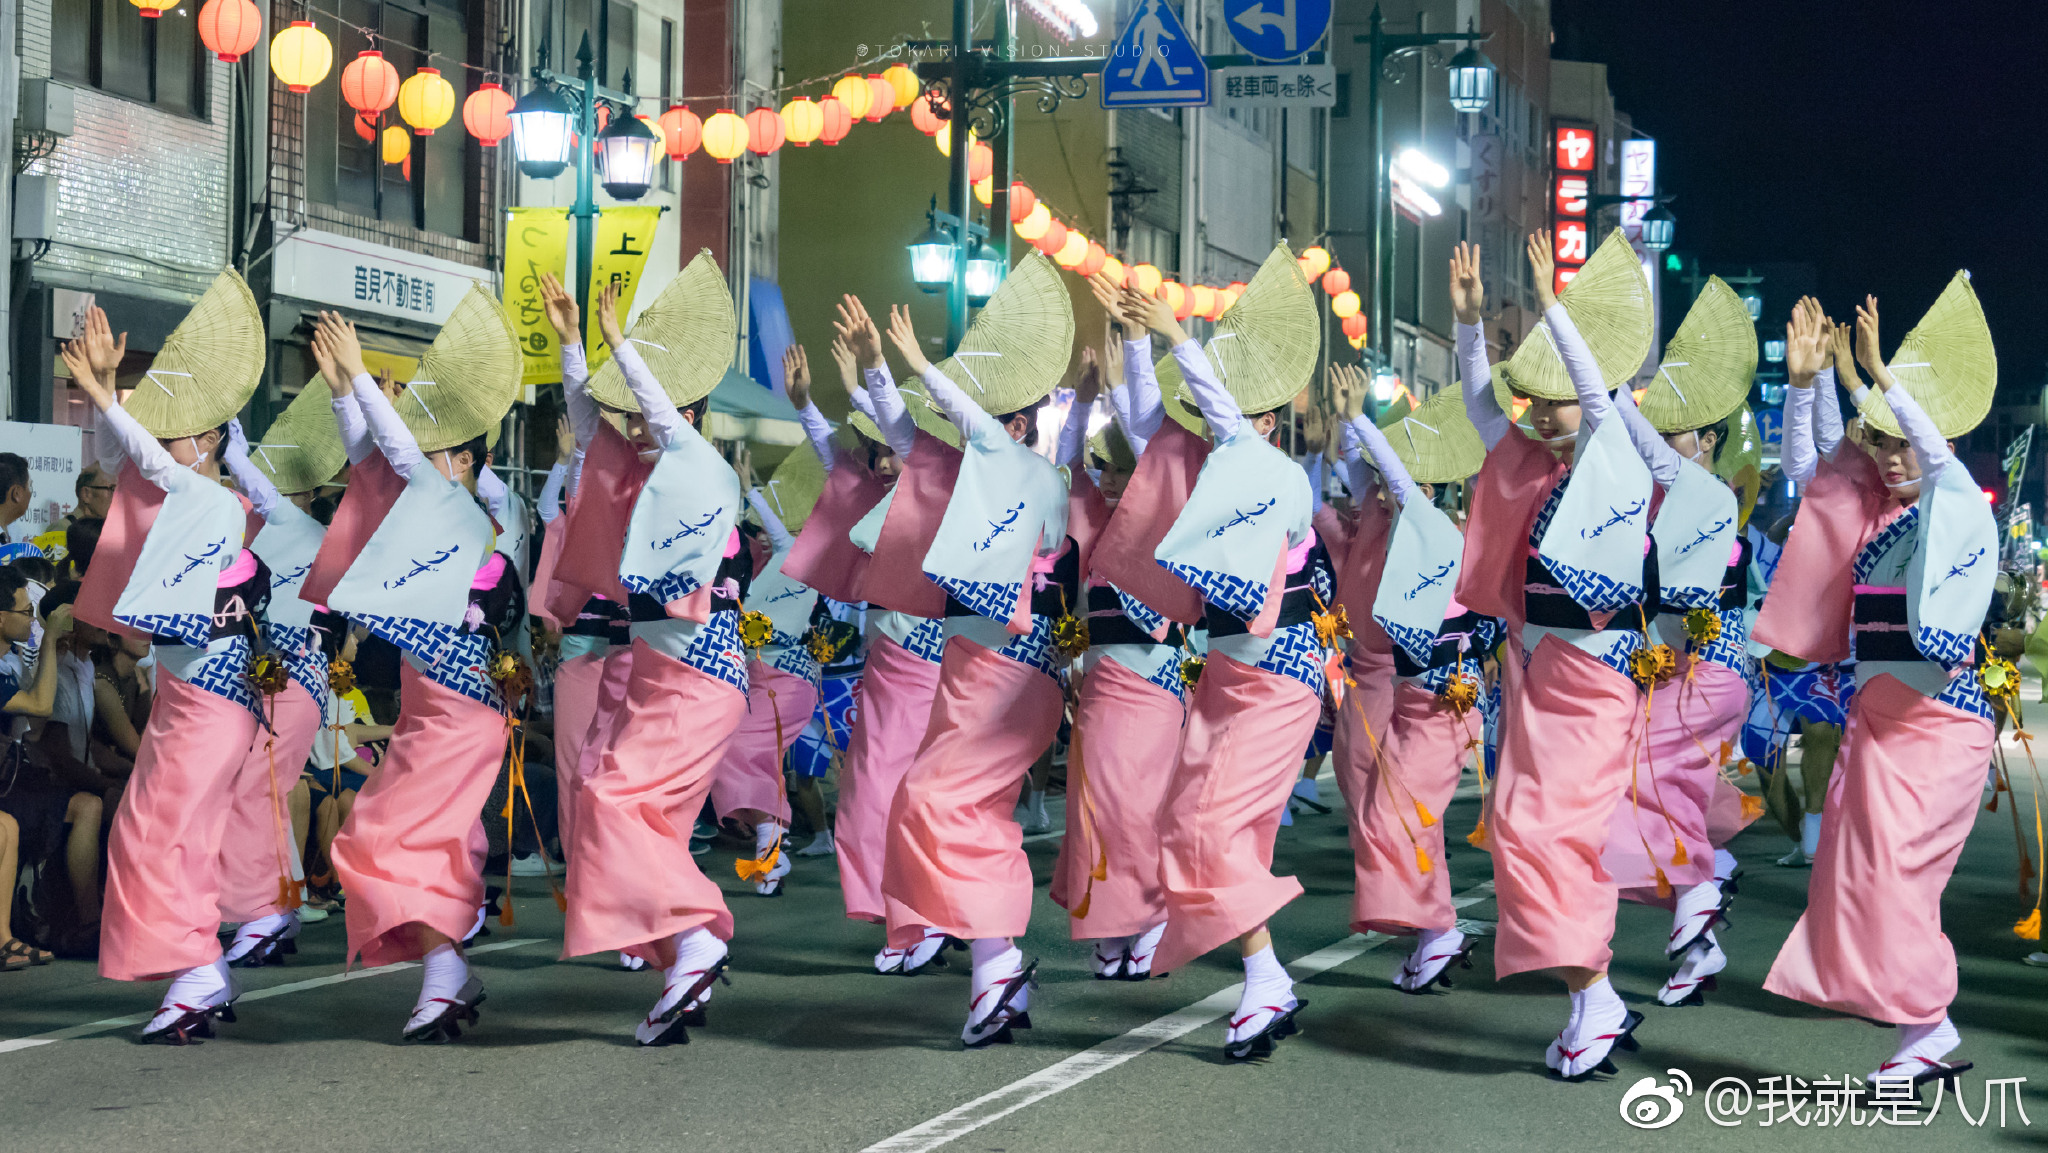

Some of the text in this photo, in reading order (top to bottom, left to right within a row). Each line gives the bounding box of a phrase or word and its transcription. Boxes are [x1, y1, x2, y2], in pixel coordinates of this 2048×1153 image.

[1225, 74, 1332, 98] 軽車両を除く
[1477, 141, 1498, 218] くすり
[1558, 131, 1591, 283] ヤラカ
[23, 456, 74, 473] の場所取りは
[271, 562, 313, 589] うず
[1944, 547, 1986, 581] うず
